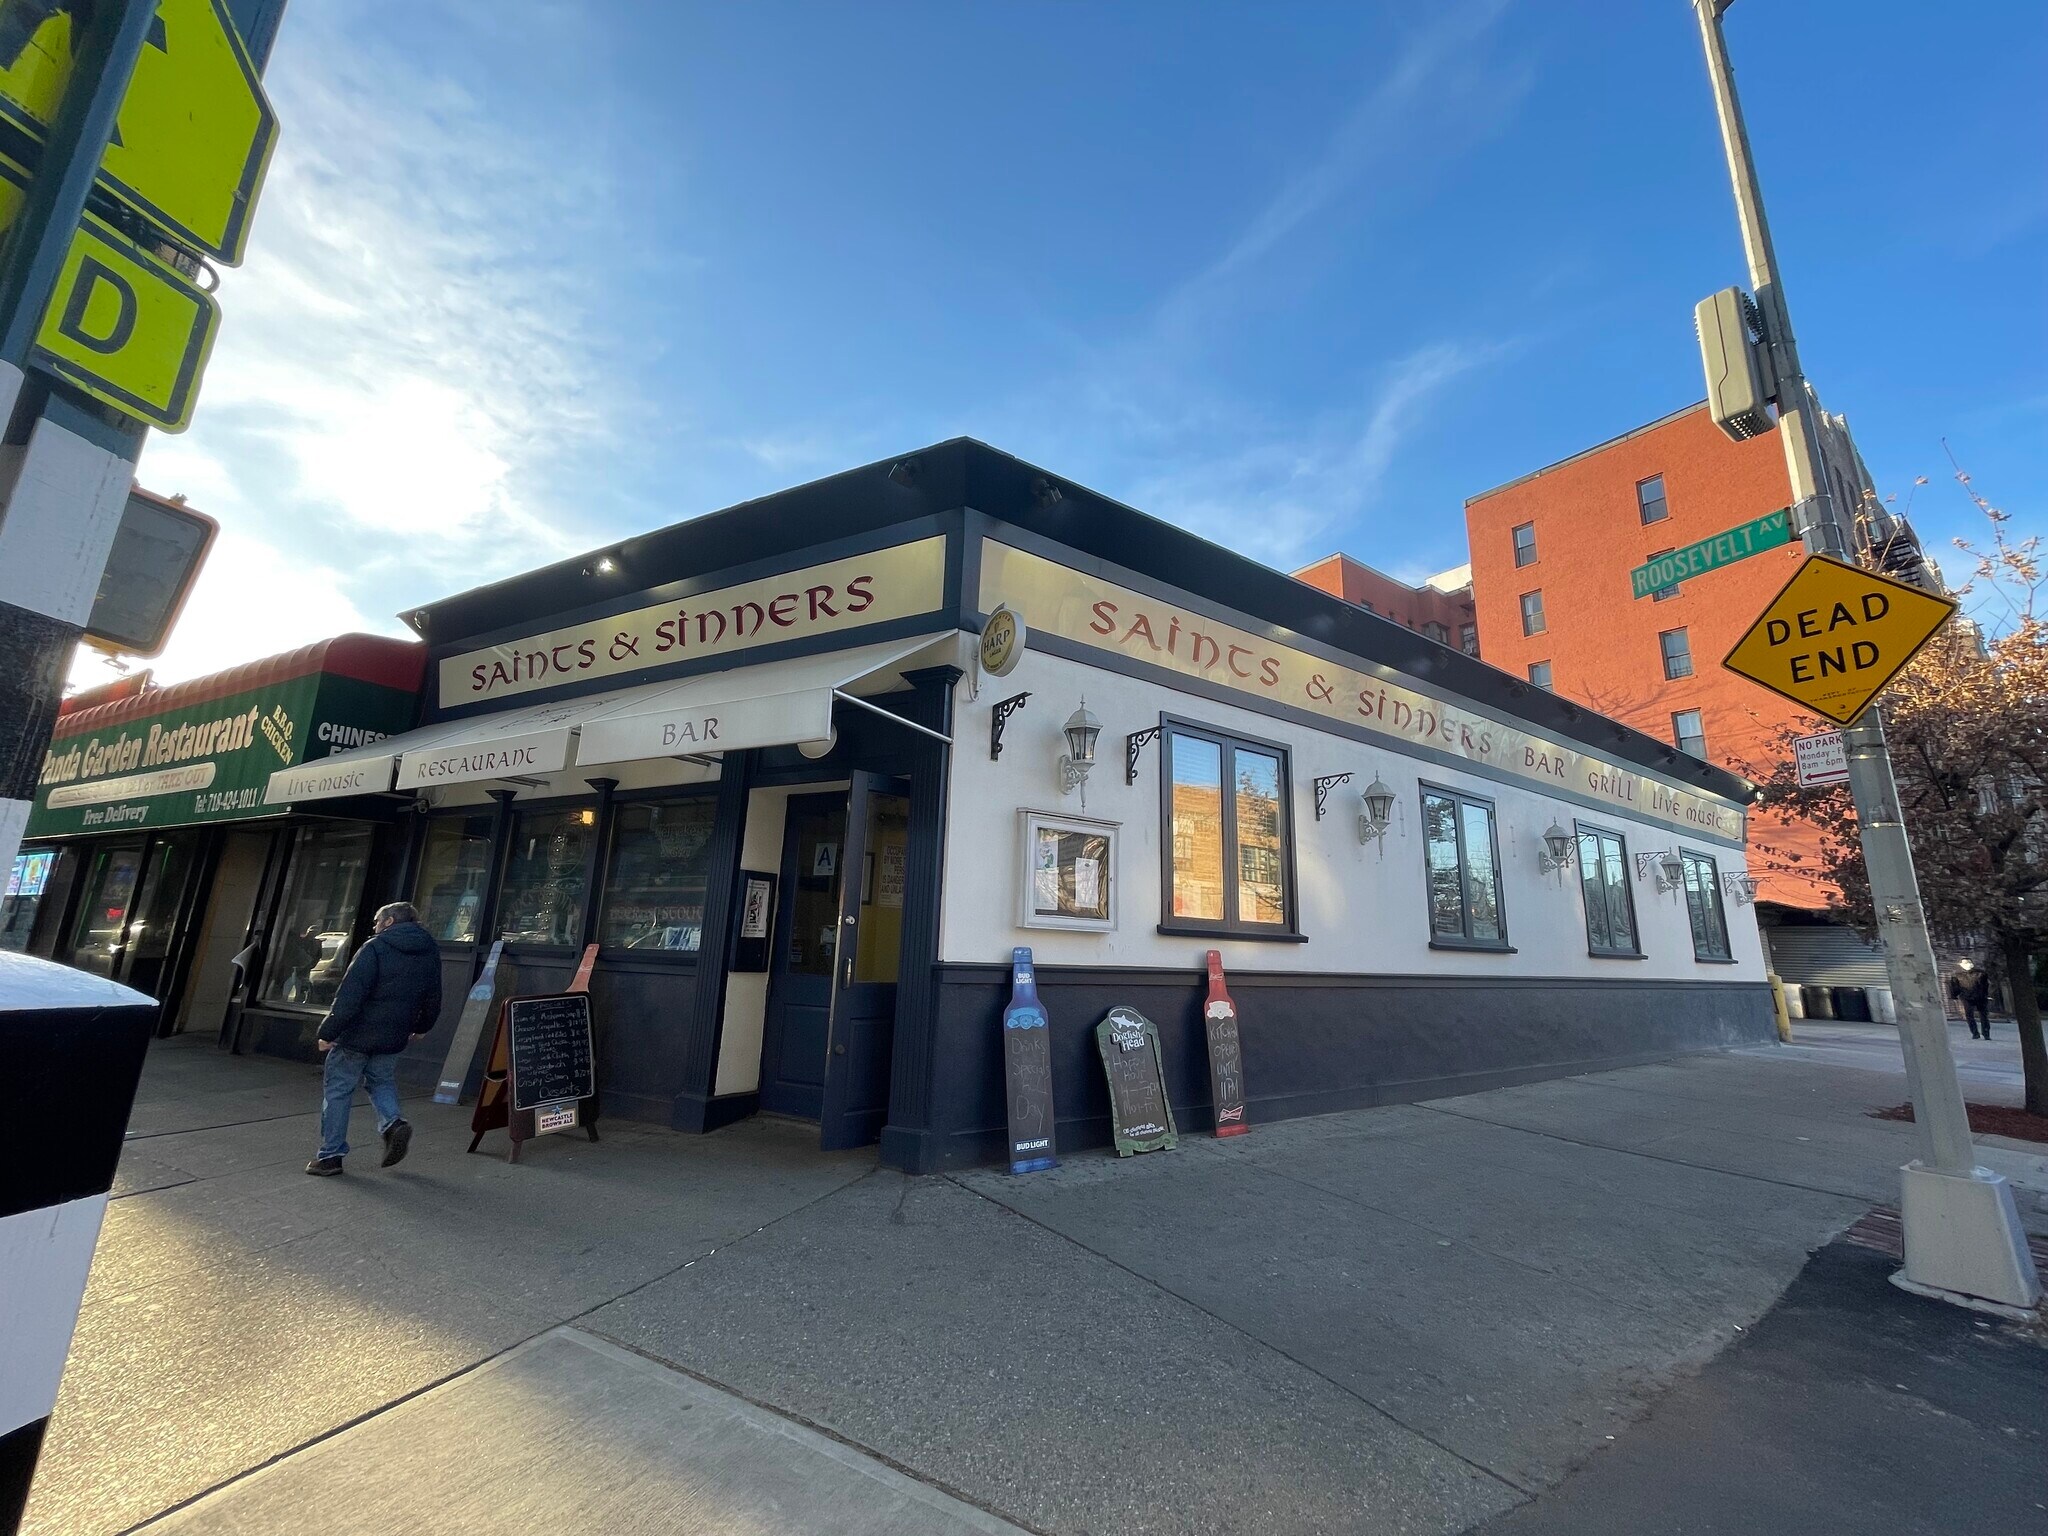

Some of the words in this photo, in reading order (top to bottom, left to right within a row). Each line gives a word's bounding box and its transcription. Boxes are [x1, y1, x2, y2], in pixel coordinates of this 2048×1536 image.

[1636, 527, 1752, 594] ROOSEVELT
[1759, 513, 1785, 536] AV
[1766, 592, 1890, 647] DEAD
[608, 632, 640, 661] &
[984, 629, 1010, 654] HARP
[1790, 640, 1880, 684] END
[318, 722, 394, 747] CHINES
[661, 716, 720, 748] BAR
[1305, 674, 1334, 704] &
[1524, 746, 1565, 778] BAR
[81, 732, 143, 779] Garden
[142, 704, 259, 767] Restaurant
[261, 715, 294, 765] CHICKEN
[1799, 741, 1813, 751] NO
[1816, 734, 1843, 748] PARK
[417, 745, 538, 779] RESTAURANT
[1800, 749, 1830, 761] Monday
[1801, 760, 1819, 770] 8am
[1826, 757, 1844, 767] 6pm
[83, 809, 104, 826] Free
[104, 805, 149, 823] Delivery
[817, 846, 832, 867] A
[1113, 1030, 1141, 1043] Dogfish
[1122, 1036, 1145, 1051] Head
[542, 1113, 573, 1123] NEWCASTLE
[542, 1120, 563, 1129] BROWN
[1016, 1141, 1030, 1151] BUD
[1030, 1140, 1048, 1149] LIGHT
